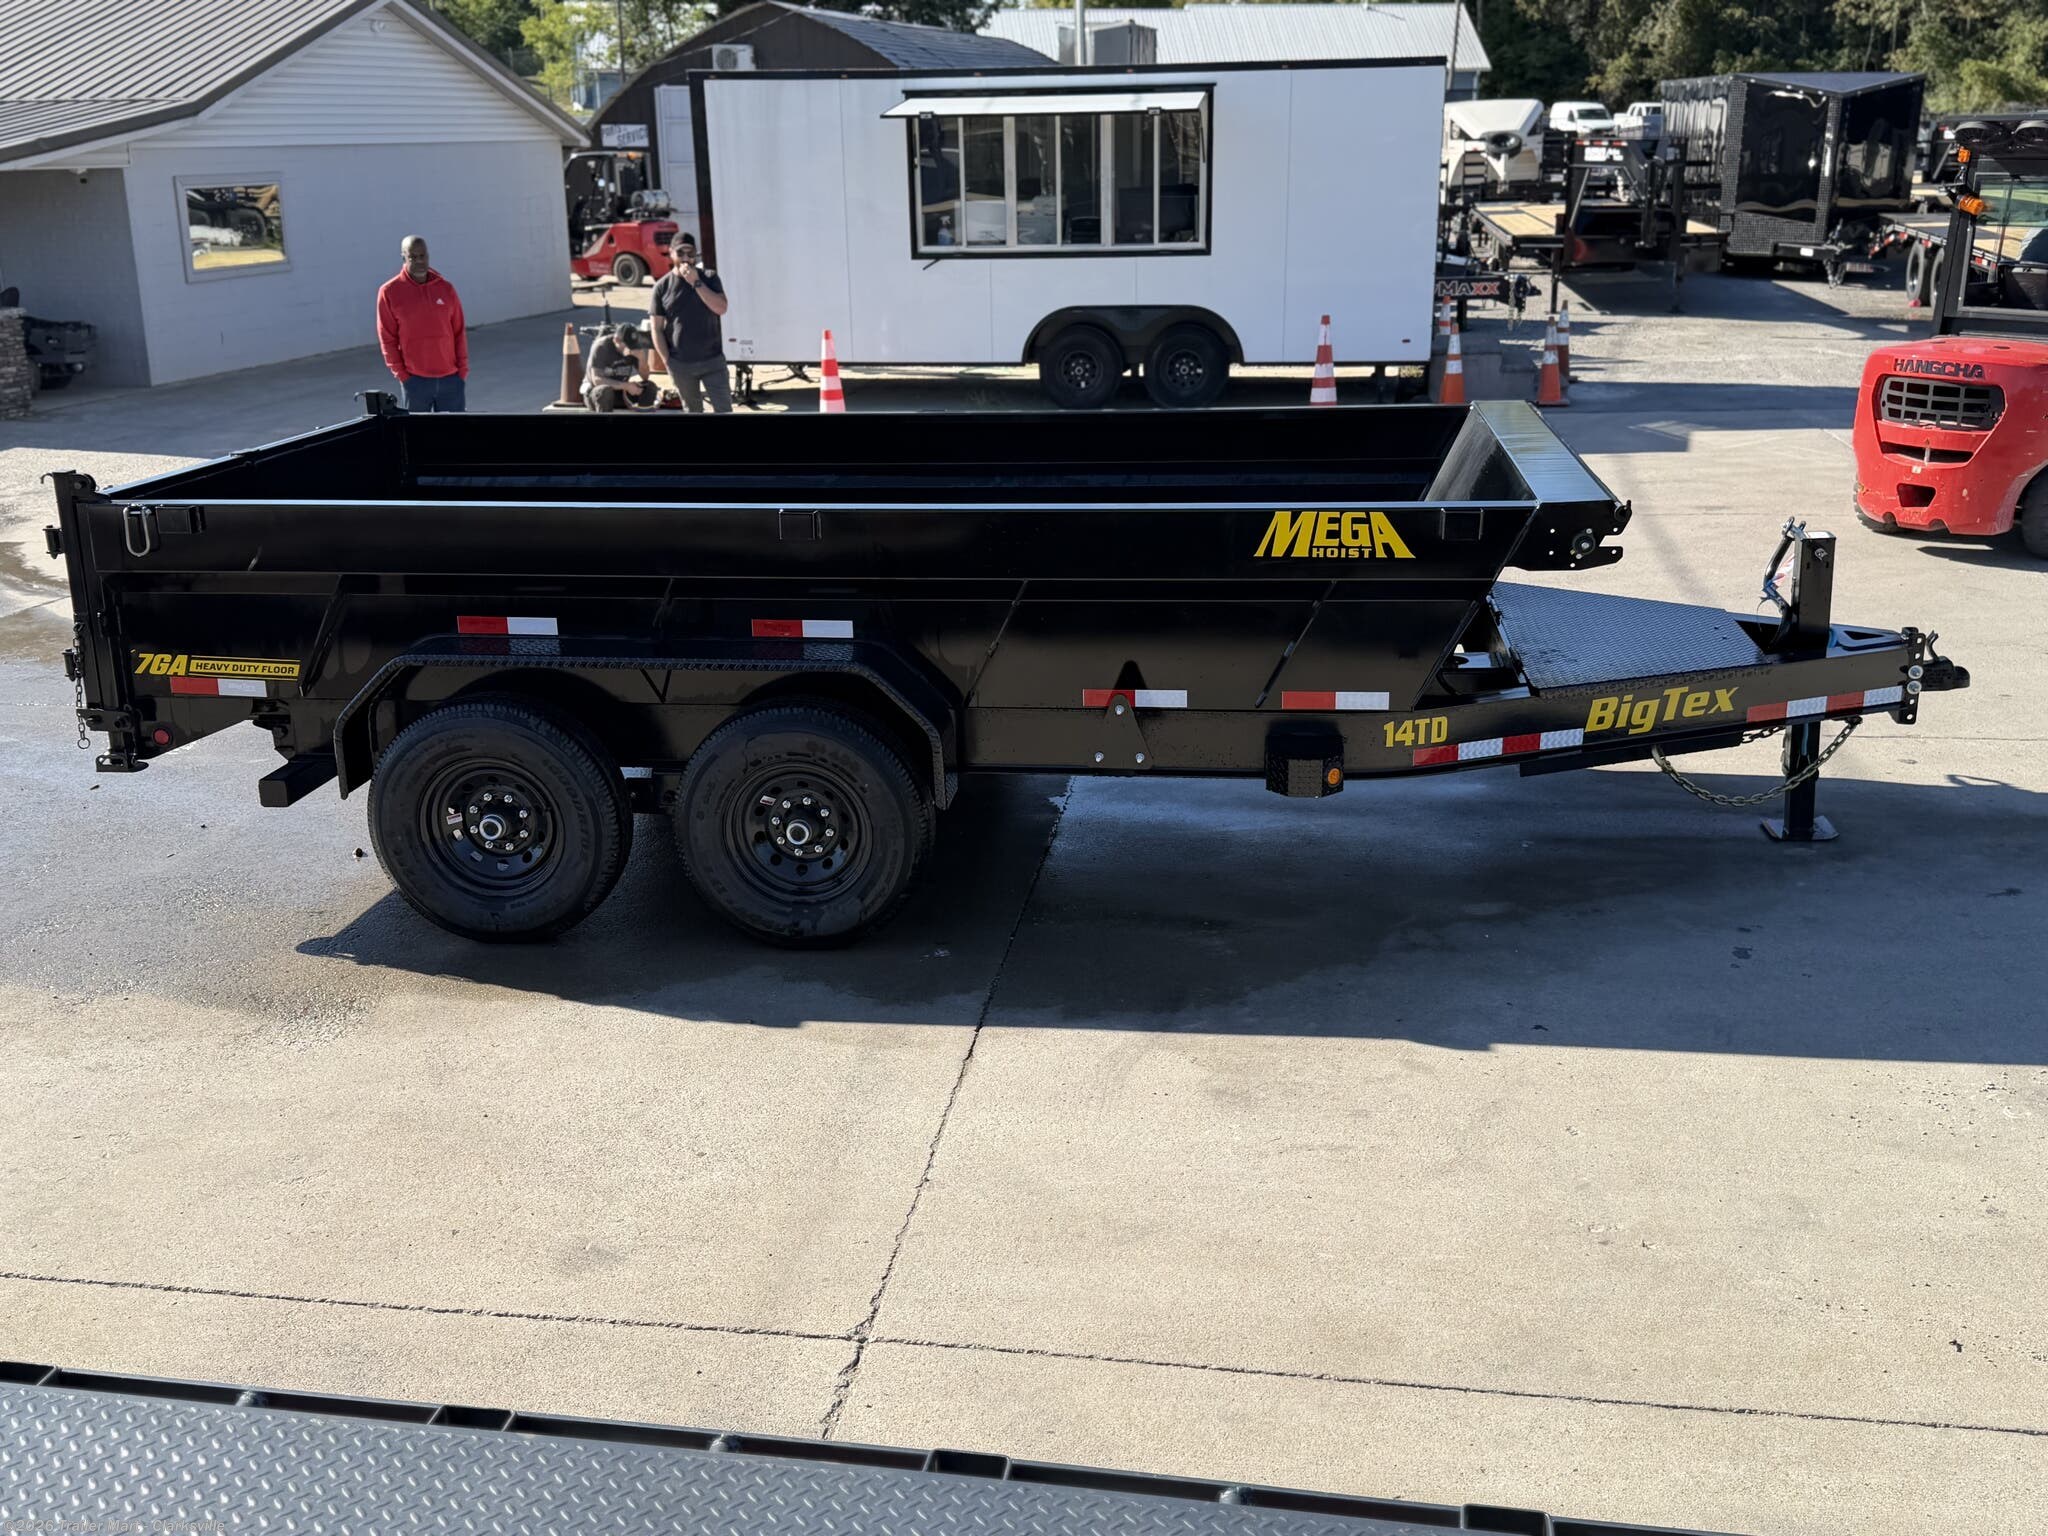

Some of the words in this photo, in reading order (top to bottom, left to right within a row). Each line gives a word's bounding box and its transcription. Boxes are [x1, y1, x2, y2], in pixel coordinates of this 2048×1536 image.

[1434, 280, 1500, 296] MAXX
[1893, 358, 1985, 378] HANGCHA
[1253, 511, 1416, 559] MEGA
[1311, 547, 1373, 559] HOIST
[134, 653, 188, 676] 7GA
[195, 662, 230, 672] HEAVY
[231, 664, 259, 674] DUTY
[261, 665, 295, 675] FLOOR
[1583, 686, 1739, 735] BigTex
[1383, 715, 1448, 748] 14TD
